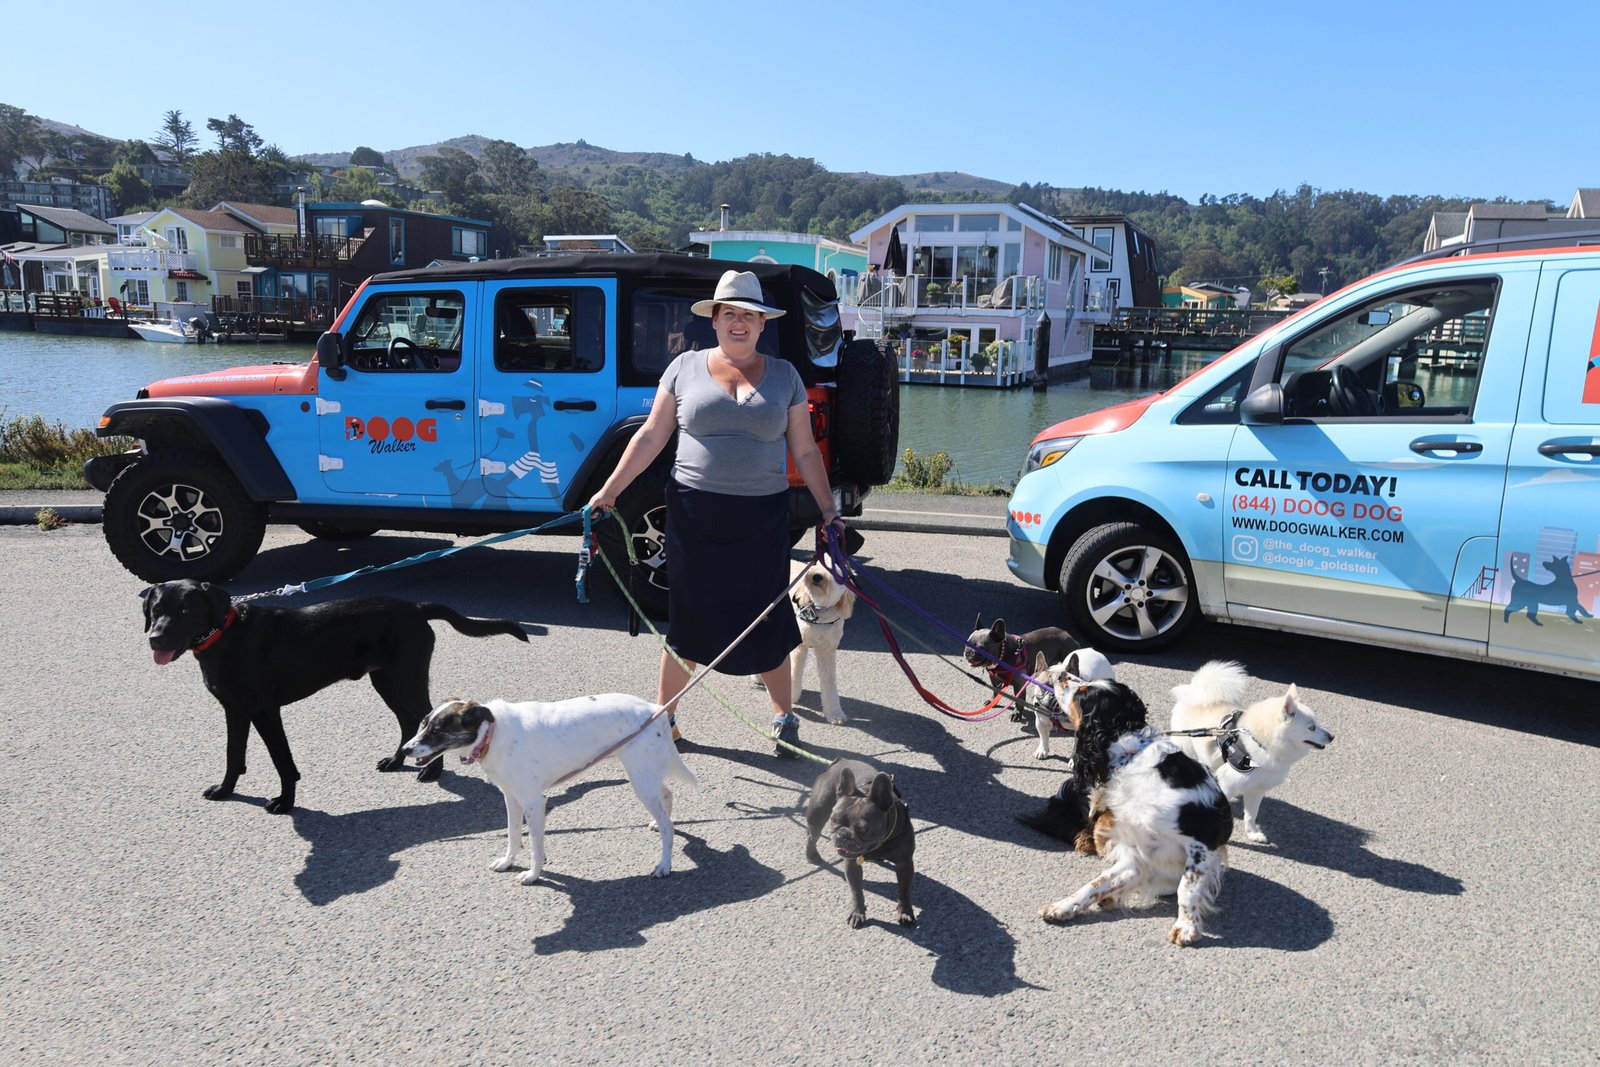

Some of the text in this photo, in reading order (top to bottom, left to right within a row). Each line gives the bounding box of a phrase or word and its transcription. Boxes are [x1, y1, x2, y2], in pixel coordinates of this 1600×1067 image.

[345, 416, 437, 442] DOOG
[368, 439, 416, 455] Walker
[1235, 467, 1397, 498] CALL TODAY!
[1232, 494, 1403, 522] (844) DOOG DOG
[1232, 516, 1404, 543] WWW.DOOGWALKER.COM
[1263, 537, 1377, 560] @the_doog_walker
[1262, 552, 1379, 575] @doogie_goldstein
